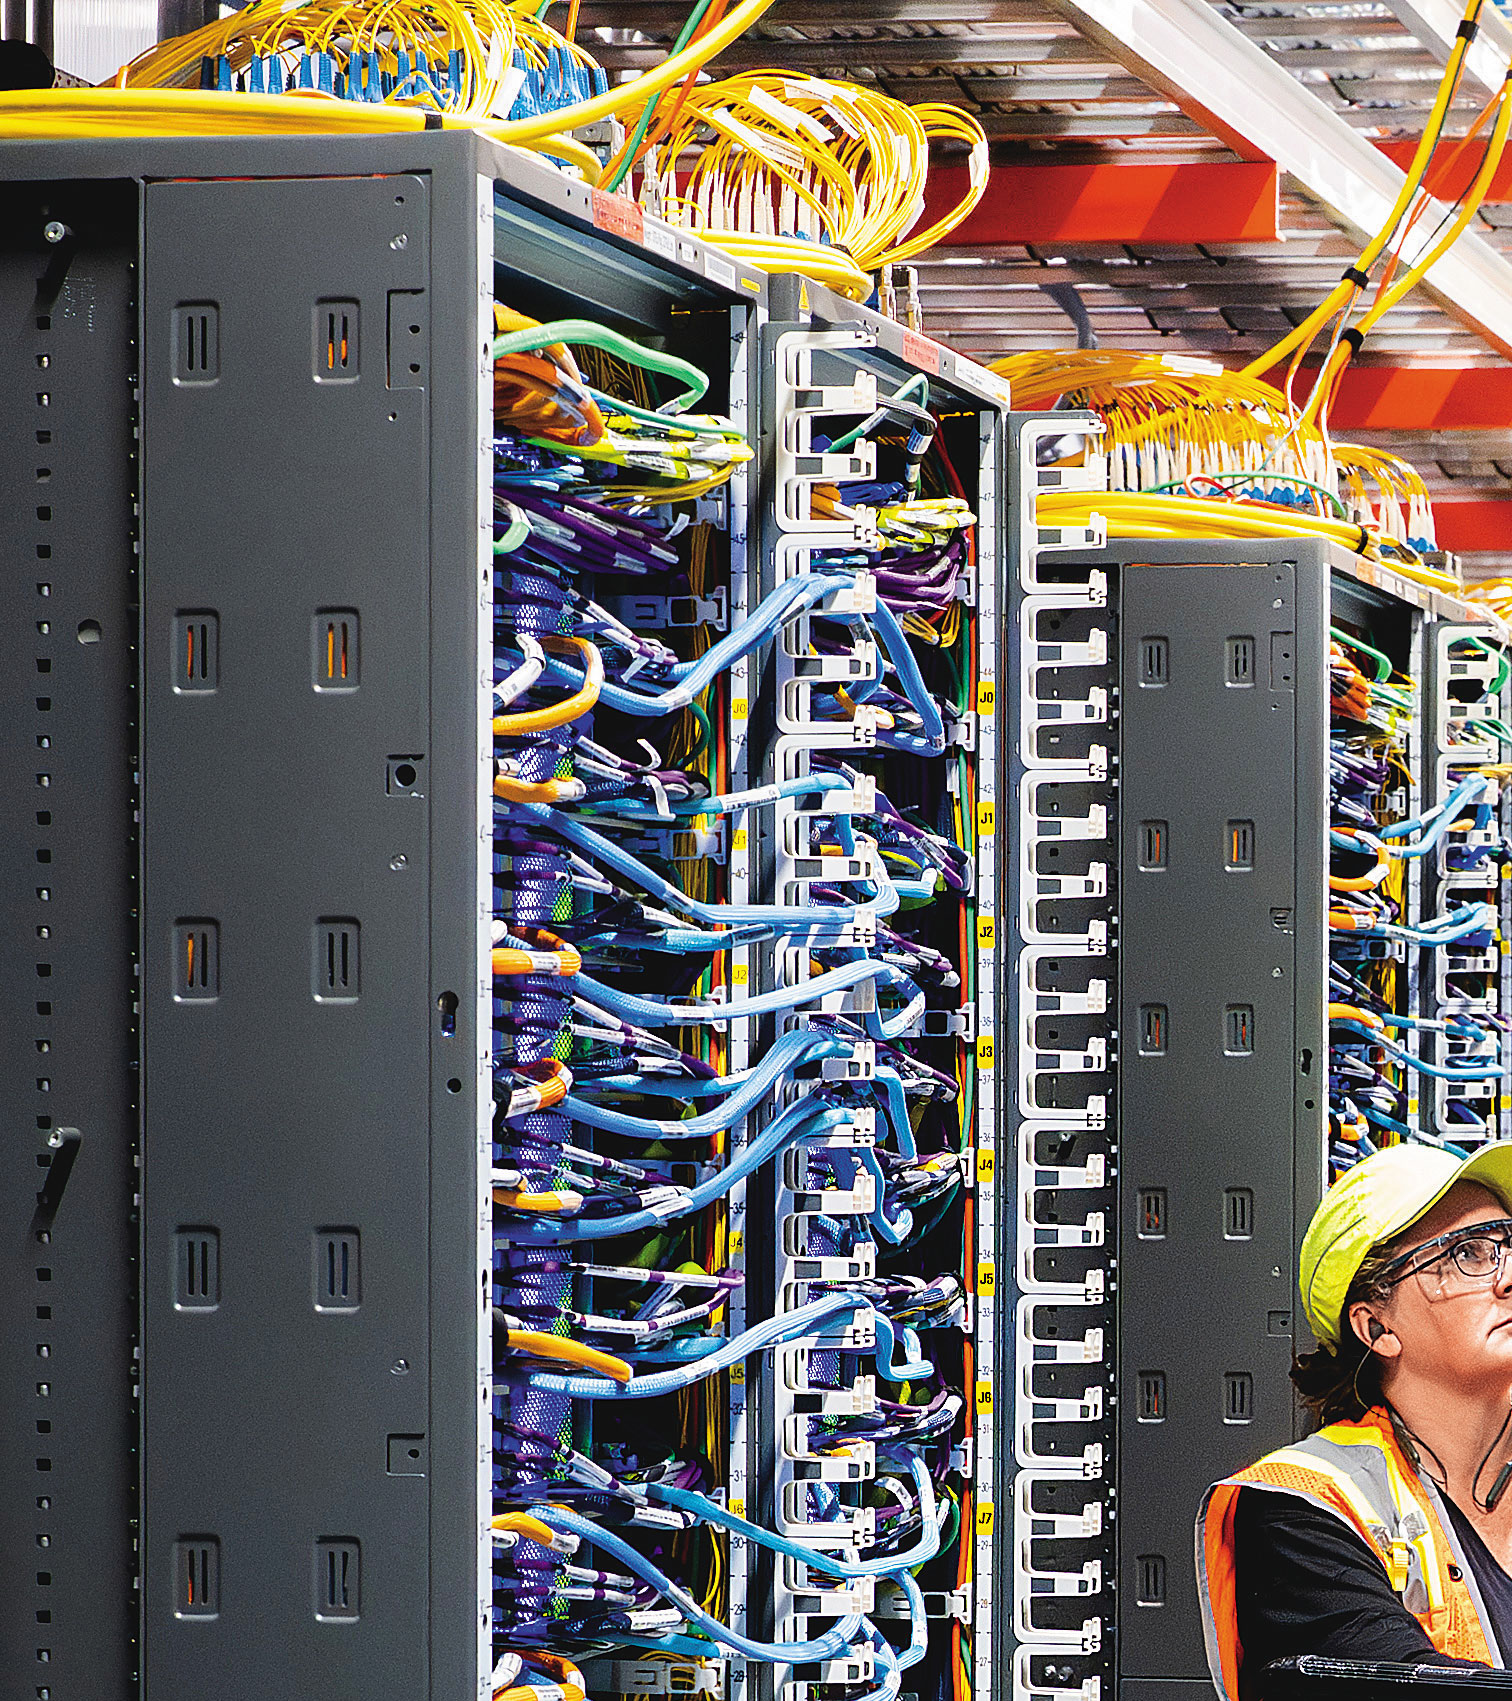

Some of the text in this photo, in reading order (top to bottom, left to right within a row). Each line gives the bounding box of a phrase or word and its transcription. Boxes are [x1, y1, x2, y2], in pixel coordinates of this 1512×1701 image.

[733, 400, 744, 411] 47
[982, 493, 991, 503] 47
[734, 533, 745, 544] 45
[982, 551, 991, 561] 46
[982, 609, 992, 619] 45
[980, 692, 993, 702] J0
[983, 725, 992, 735] 43
[735, 734, 745, 746] 42
[983, 784, 992, 794] 42
[981, 812, 993, 823] J1
[734, 836, 746, 846] J1
[983, 842, 992, 852] 41
[982, 900, 992, 910] 40
[980, 926, 993, 937] J2
[982, 959, 991, 969] 39
[735, 970, 747, 980] J2
[979, 1046, 993, 1057] J3
[982, 1075, 991, 1085] 37
[733, 1136, 744, 1148] 36
[982, 1133, 991, 1143] 36
[979, 1159, 993, 1170] J4
[982, 1191, 991, 1201] 35
[733, 1203, 744, 1214] 35
[731, 1238, 742, 1248] J4
[982, 1249, 991, 1259] 34
[979, 1273, 993, 1284] J5
[981, 1307, 991, 1317] 33
[731, 1369, 744, 1379] J5
[733, 1404, 744, 1415] 32
[981, 1424, 990, 1434] 31
[734, 1470, 743, 1482] 31
[981, 1483, 990, 1493] 30
[978, 1513, 992, 1524] J7
[734, 1538, 744, 1549] 30
[980, 1540, 989, 1550] 29
[734, 1604, 744, 1615] 29
[733, 1670, 744, 1682] 28
